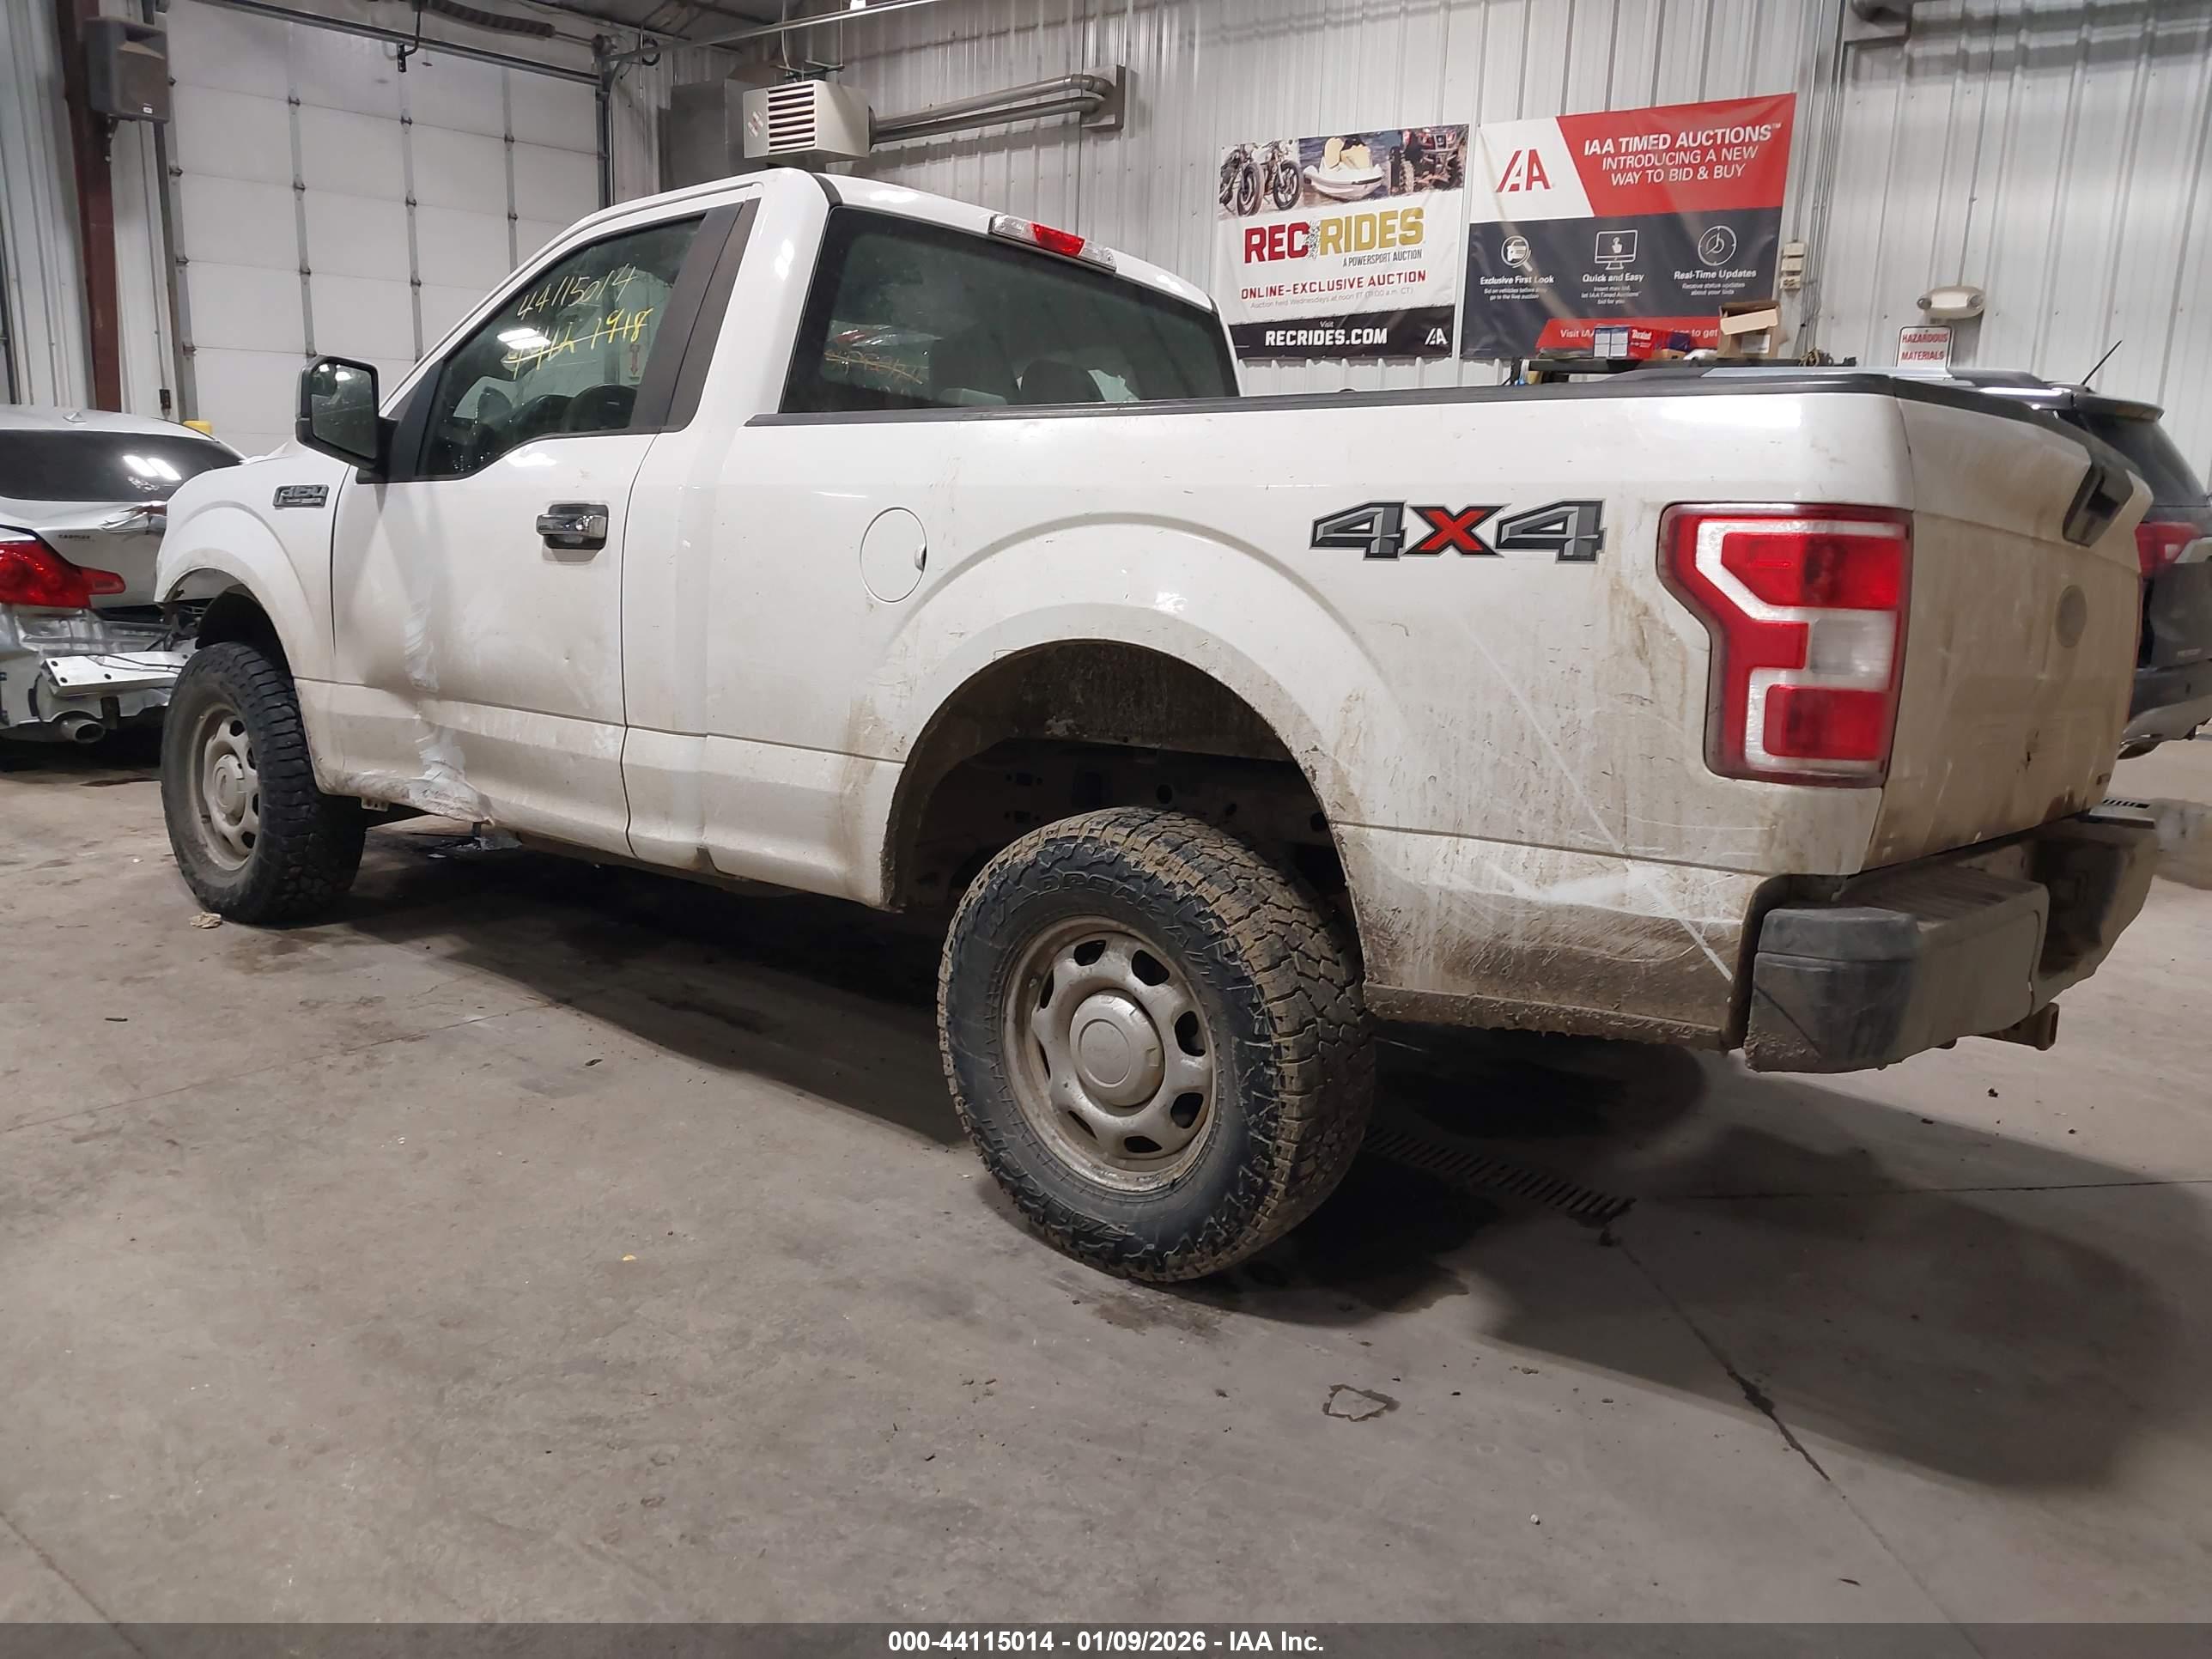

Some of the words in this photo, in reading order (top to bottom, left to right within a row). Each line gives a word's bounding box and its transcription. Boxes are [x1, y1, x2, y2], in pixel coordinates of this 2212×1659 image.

[1584, 138, 1614, 155] IAA
[1619, 134, 1671, 153] TIMED
[1602, 149, 1701, 170] INTRODUCING
[1705, 148, 1717, 161] A
[1721, 145, 1759, 160] NEW
[1611, 171, 1644, 186] WAY
[1646, 168, 1664, 183] TO
[1668, 167, 1692, 181] BID
[1697, 166, 1708, 180] &
[1713, 163, 1746, 179] BUY
[1245, 222, 1310, 264] REC
[1319, 207, 1425, 256] RIDES
[1343, 258, 1347, 267] A
[1348, 252, 1391, 267] POWERSPORT
[1393, 249, 1423, 263] AUCTION
[1480, 275, 1514, 285] Exclusive
[1515, 275, 1532, 284] First
[1534, 275, 1554, 283] Look
[1583, 273, 1606, 283] Quick
[1607, 273, 1623, 282] and
[1625, 272, 1644, 282] Easy
[1674, 270, 1717, 280] Real-Time
[1718, 269, 1757, 280] Updates
[517, 263, 638, 320] 44115014
[1241, 277, 1364, 300] ONLINE-EXCLUSIVE
[1367, 270, 1427, 287] AUCTION
[1265, 328, 1388, 346] RECRIDES.COM
[1560, 329, 1579, 338] Visit
[1902, 332, 1948, 343] HAZARDOUS
[1901, 349, 1945, 361] MATERIALS
[1309, 498, 1607, 563] 4X4
